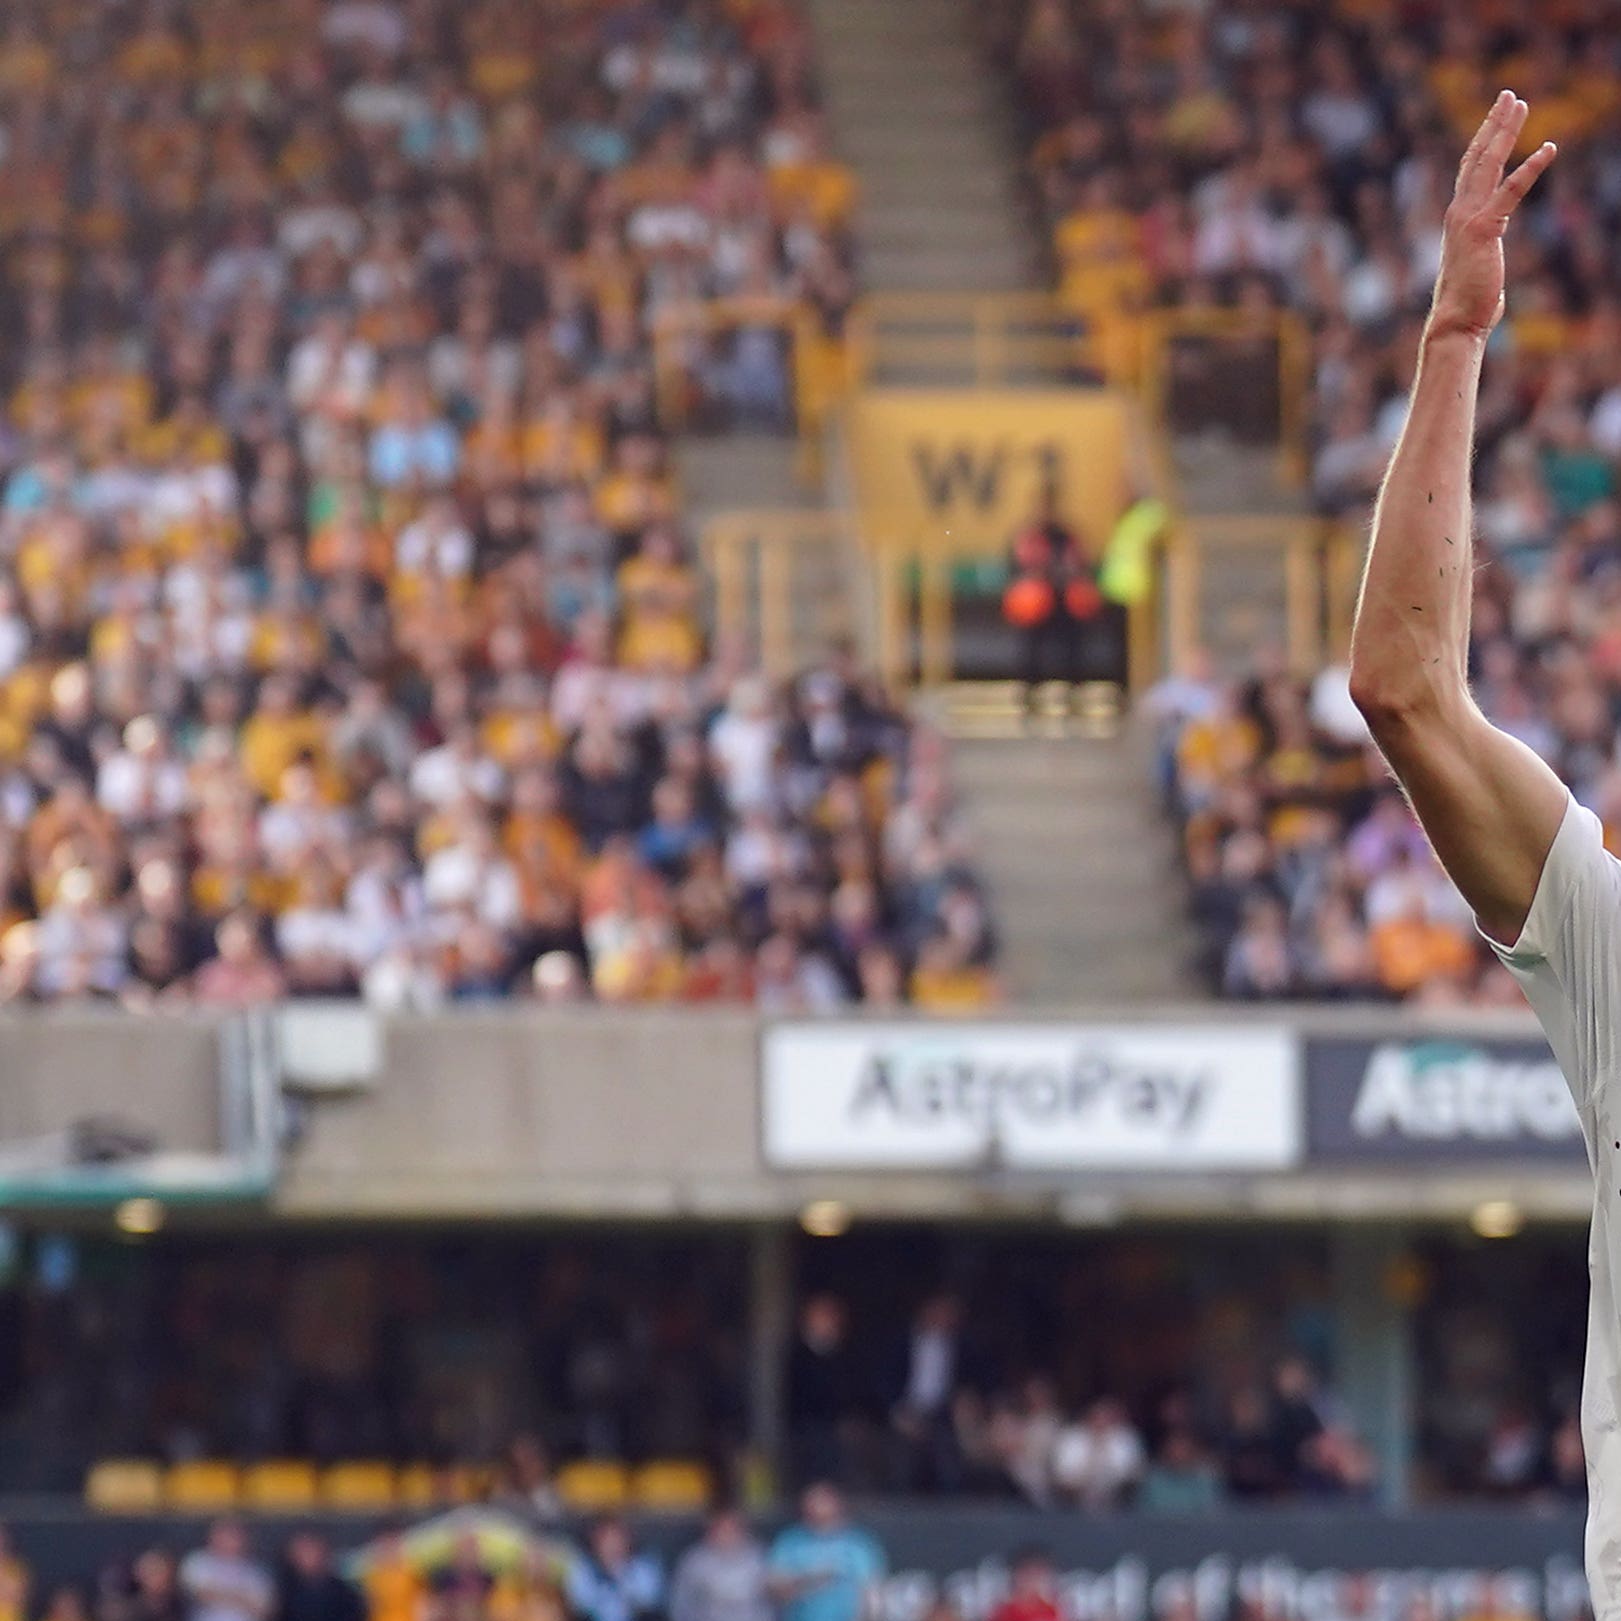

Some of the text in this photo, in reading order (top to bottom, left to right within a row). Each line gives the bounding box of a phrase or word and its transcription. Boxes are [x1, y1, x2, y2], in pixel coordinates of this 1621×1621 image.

[910, 441, 1063, 513] W1
[848, 1046, 1202, 1136] AstroPay
[1352, 1042, 1580, 1140] Astro
